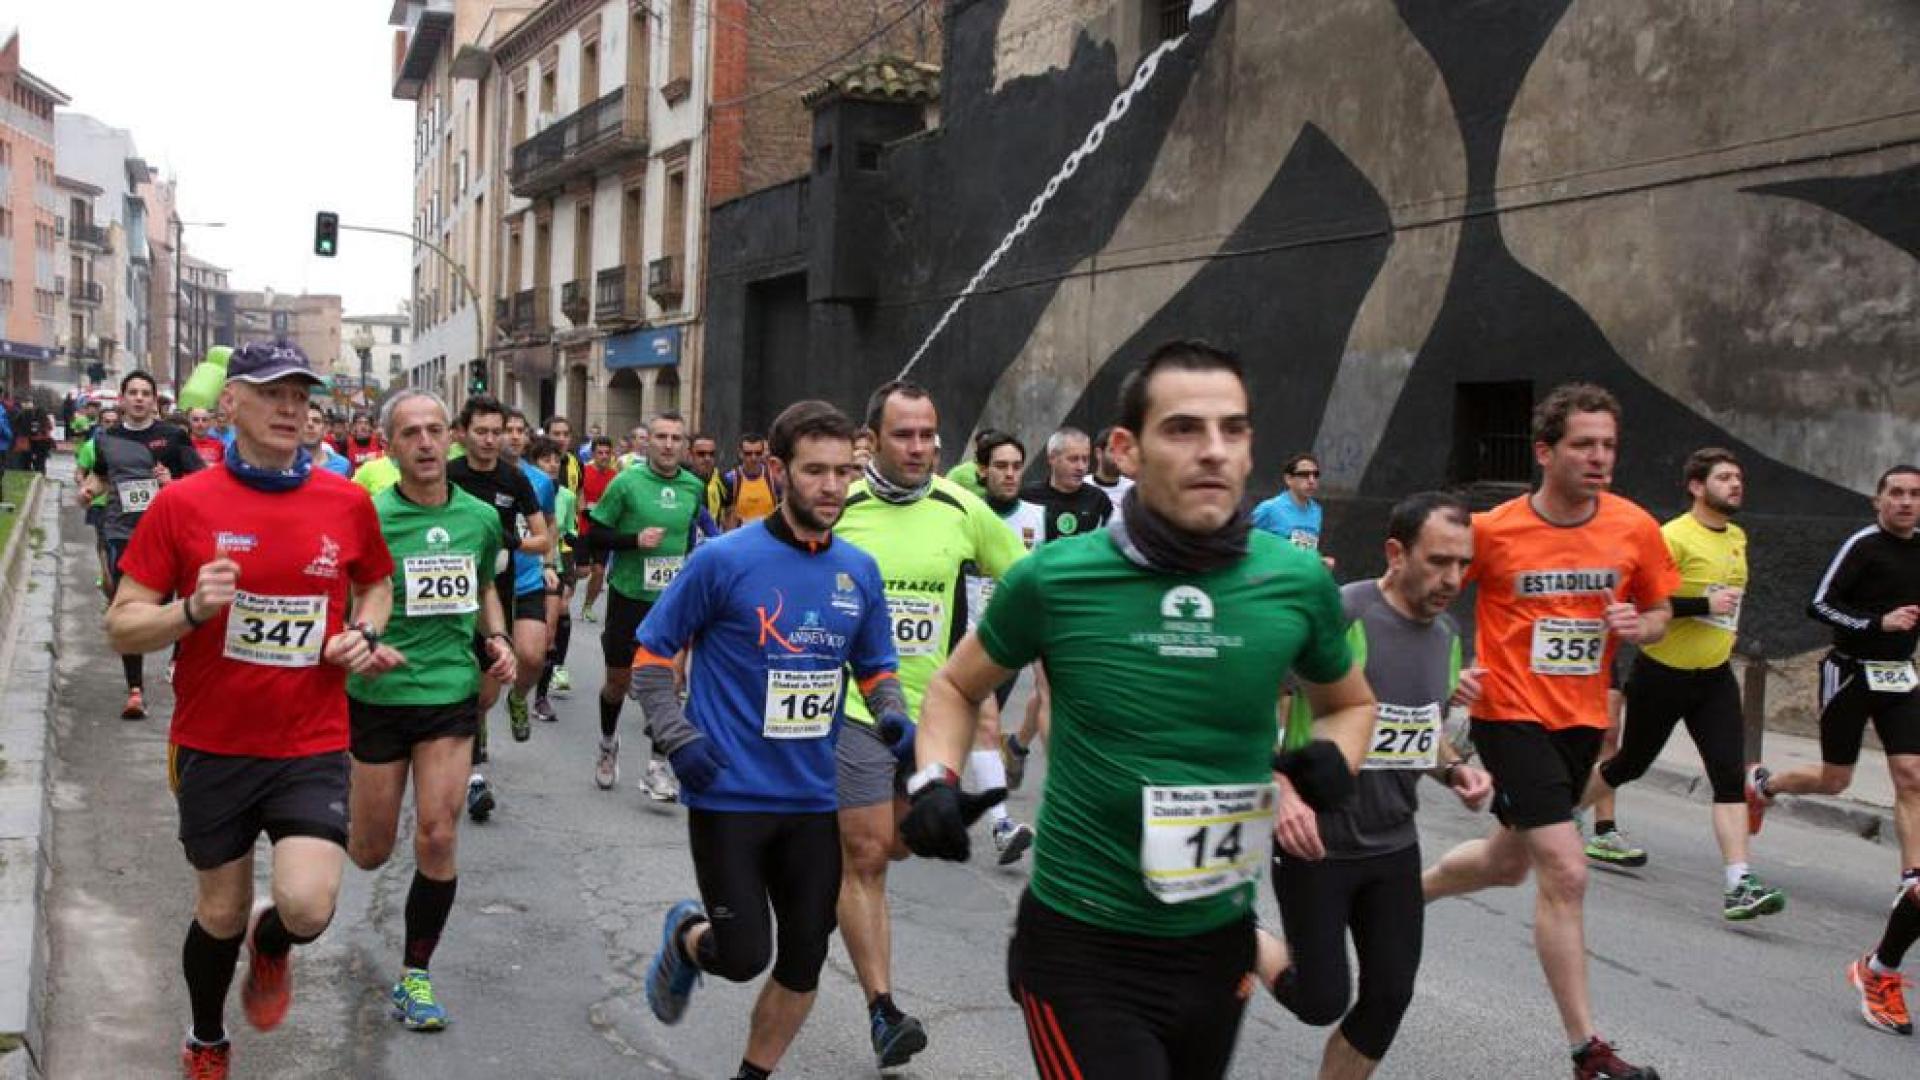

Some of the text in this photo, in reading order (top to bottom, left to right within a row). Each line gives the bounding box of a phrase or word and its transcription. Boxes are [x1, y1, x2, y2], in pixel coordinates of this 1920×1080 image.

[129, 489, 150, 503] 89
[417, 575, 470, 599] 269
[1522, 573, 1615, 592] ESTADILLA
[240, 617, 315, 648] 347
[889, 617, 934, 642] 60
[1545, 637, 1602, 662] 358
[1872, 670, 1912, 684] 584
[780, 690, 836, 720] 164
[1374, 727, 1435, 754] 276
[1186, 821, 1243, 870] 14
